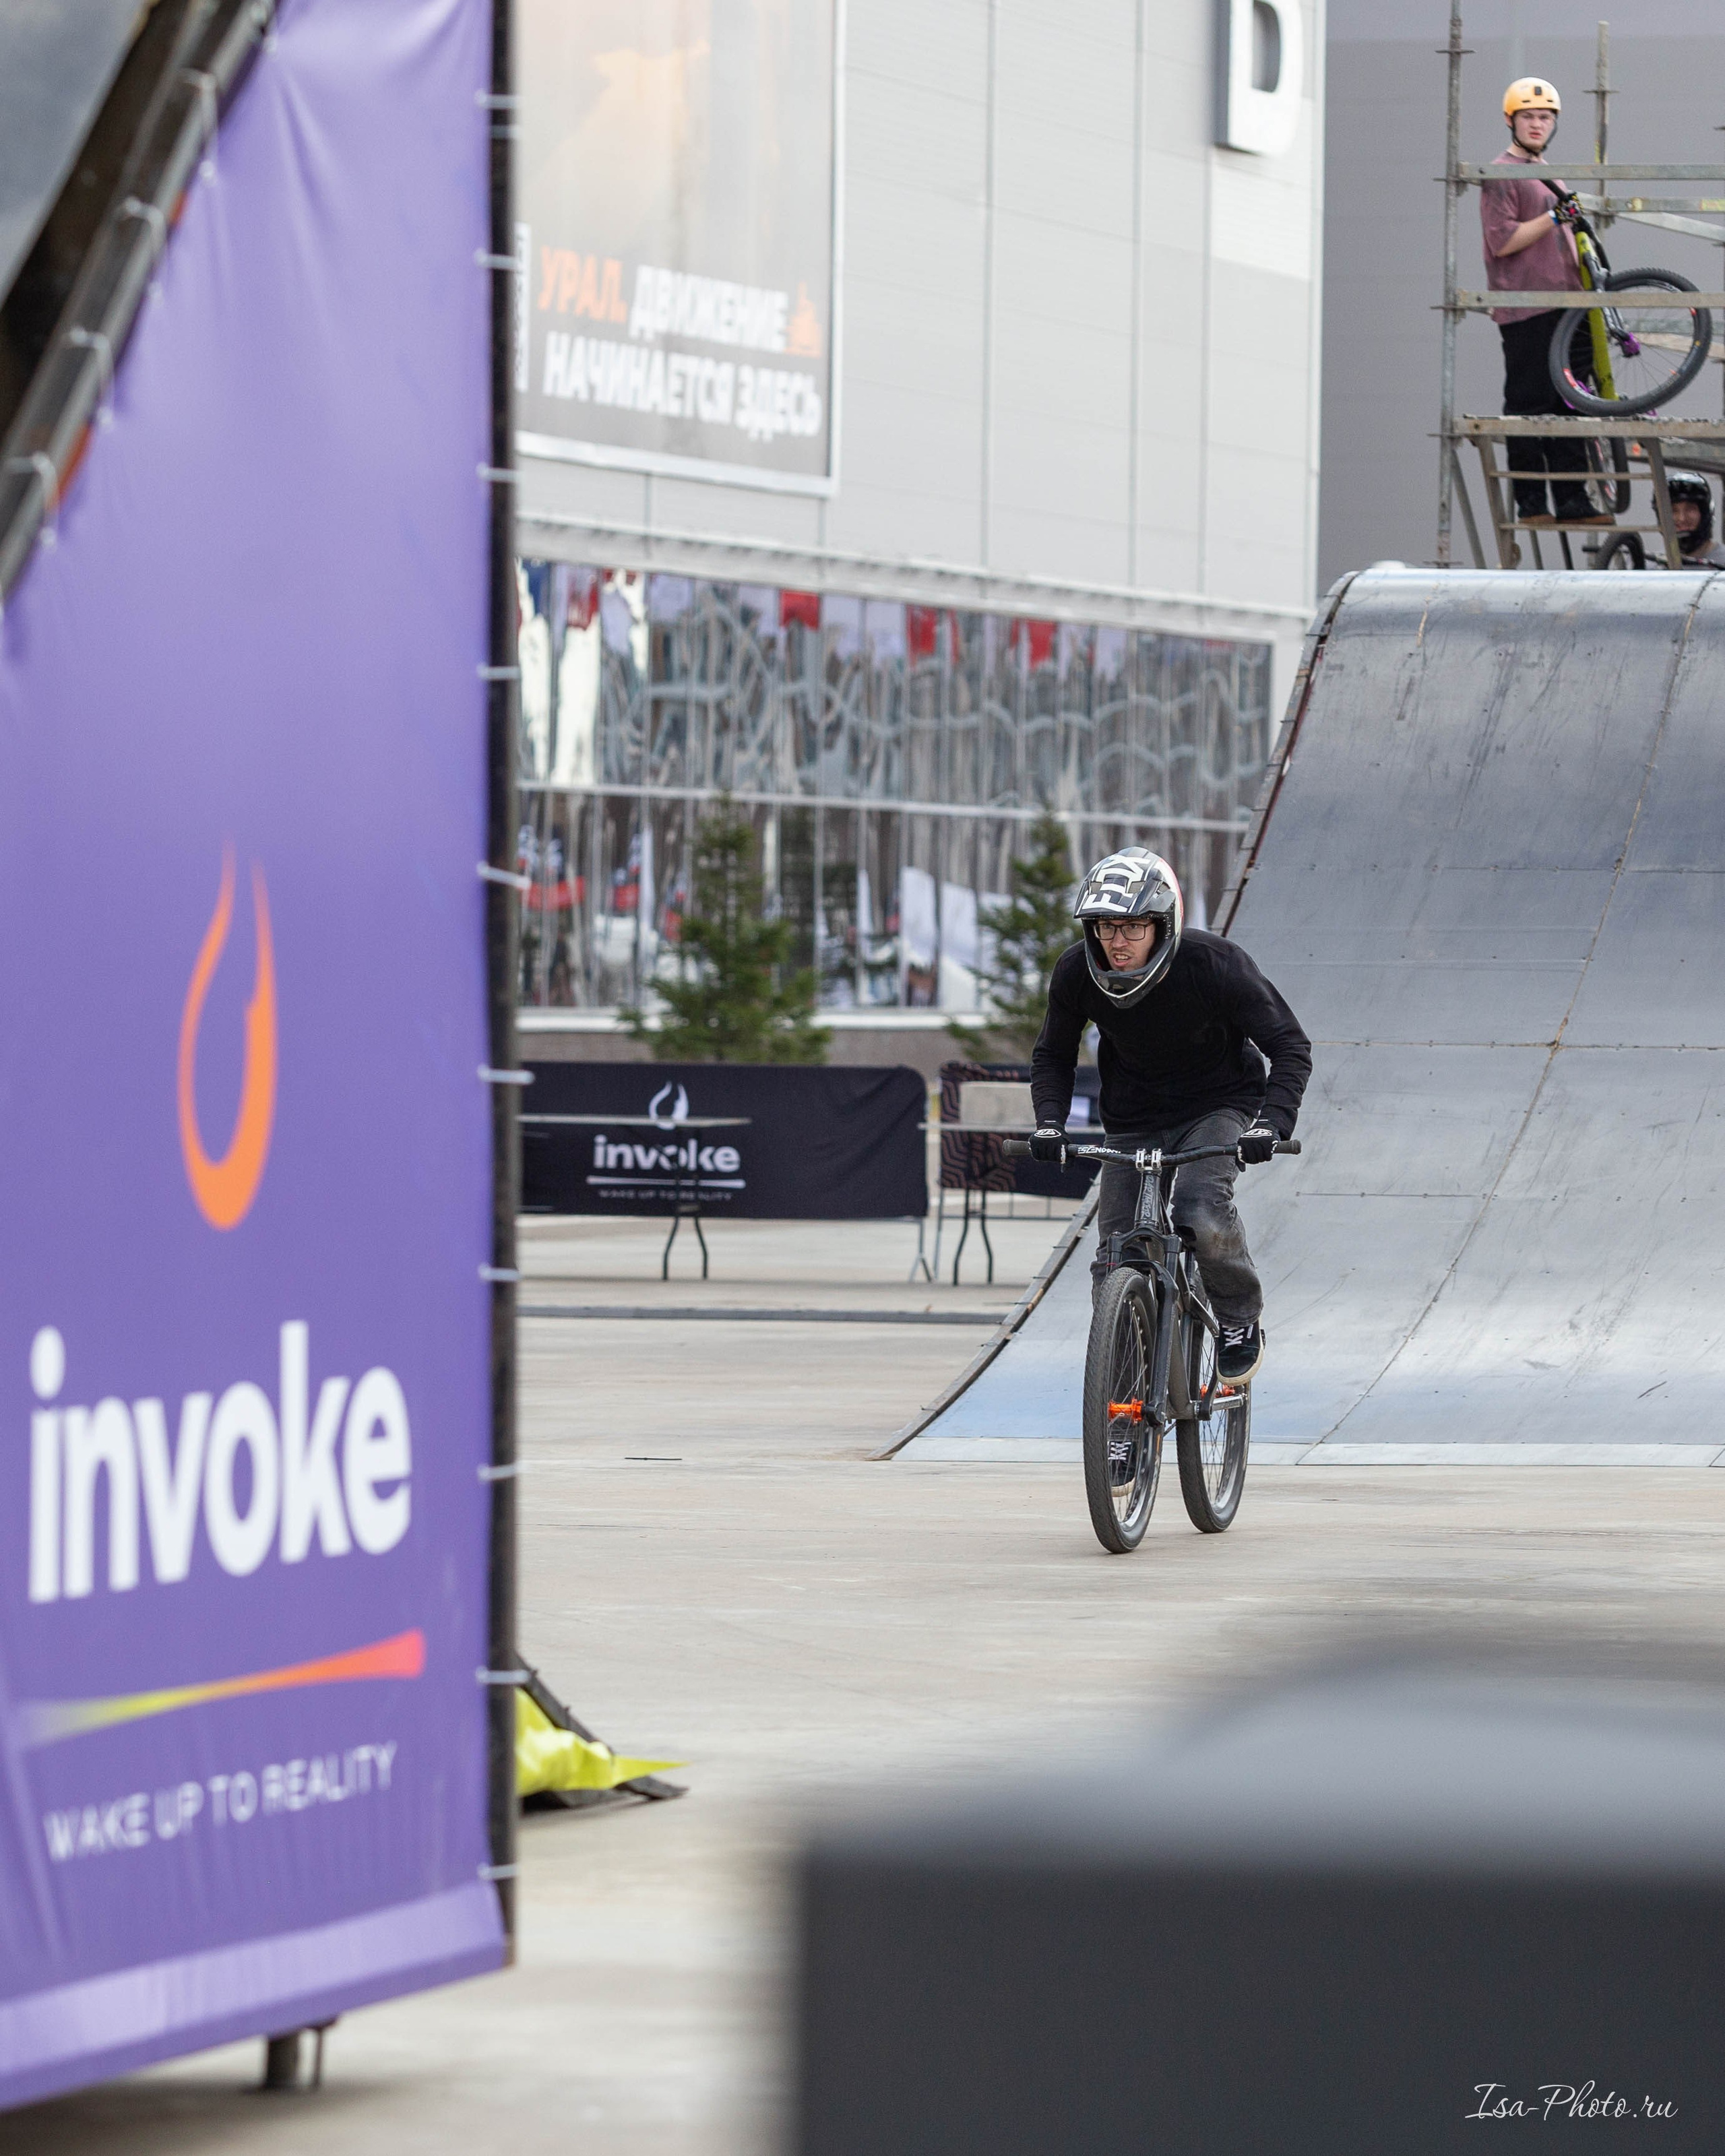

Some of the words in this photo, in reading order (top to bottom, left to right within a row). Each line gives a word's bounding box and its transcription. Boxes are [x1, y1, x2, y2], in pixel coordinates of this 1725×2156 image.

[628, 264, 788, 354] ДВИЖЕНИЕ
[542, 329, 735, 426] НАЧИНАЕТСЯ
[735, 363, 823, 444] ЗДЕСЬ
[1081, 854, 1152, 913] FOX
[593, 1134, 741, 1172] invoke
[29, 1319, 412, 1604] invoke
[43, 1792, 150, 1863] WAKE
[154, 1781, 203, 1841] UP
[207, 1770, 258, 1823] TO
[261, 1739, 398, 1816] REALITY
